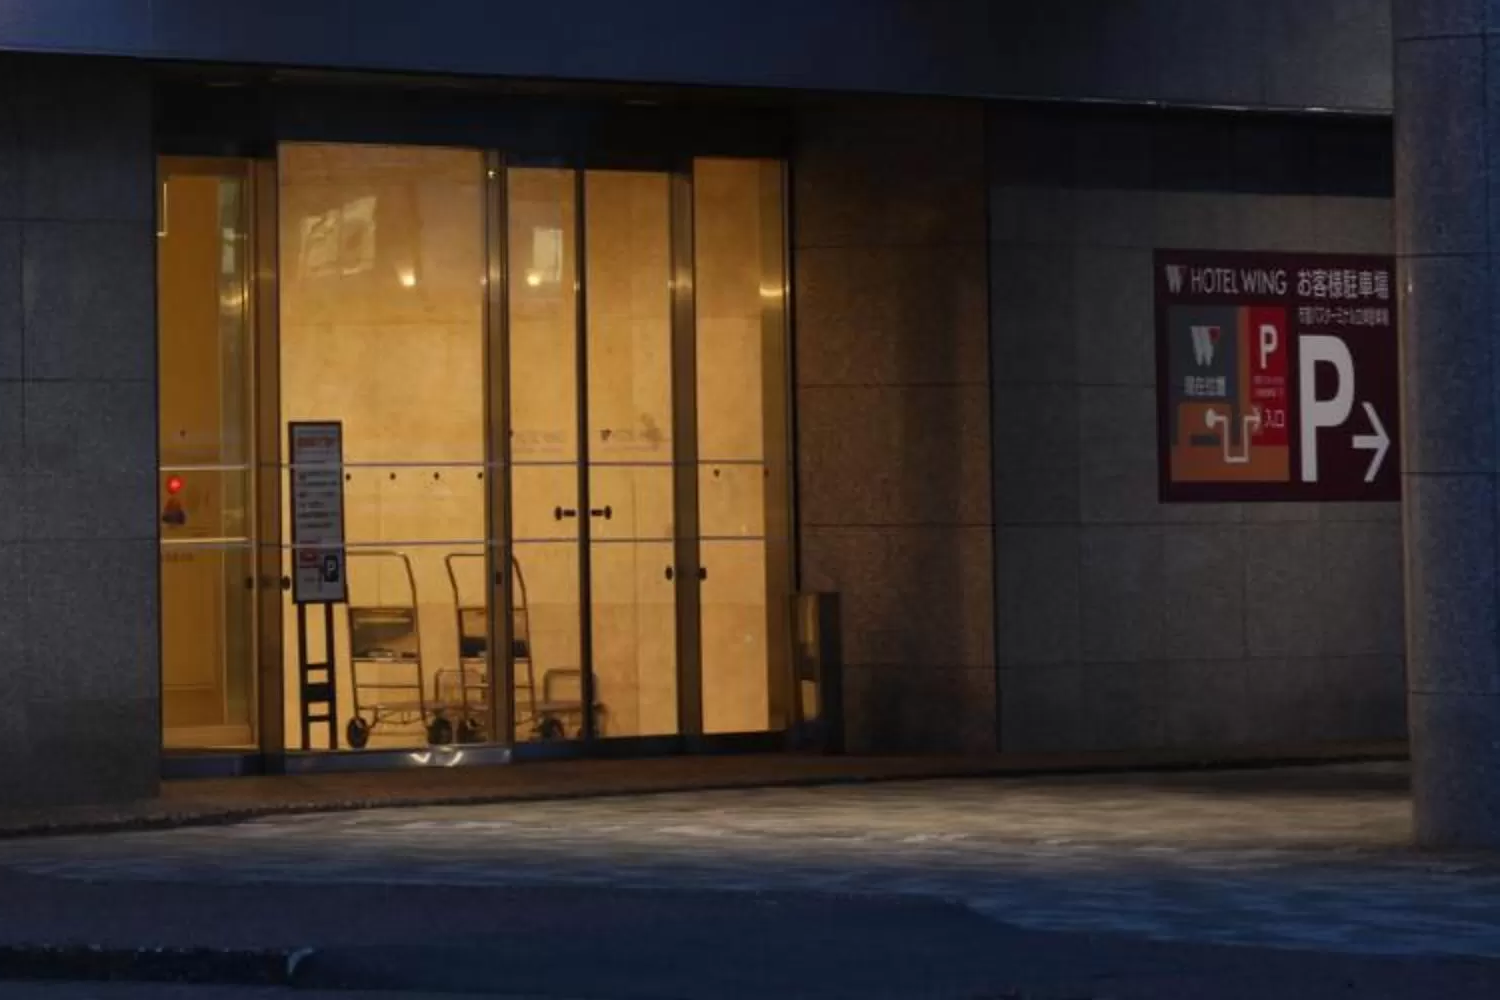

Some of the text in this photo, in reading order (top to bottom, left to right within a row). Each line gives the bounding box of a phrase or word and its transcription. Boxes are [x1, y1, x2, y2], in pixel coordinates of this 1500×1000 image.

[1191, 268, 1239, 295] HOTEL
[1241, 269, 1288, 296] WING
[1259, 324, 1278, 370] P
[1299, 334, 1355, 483] P
